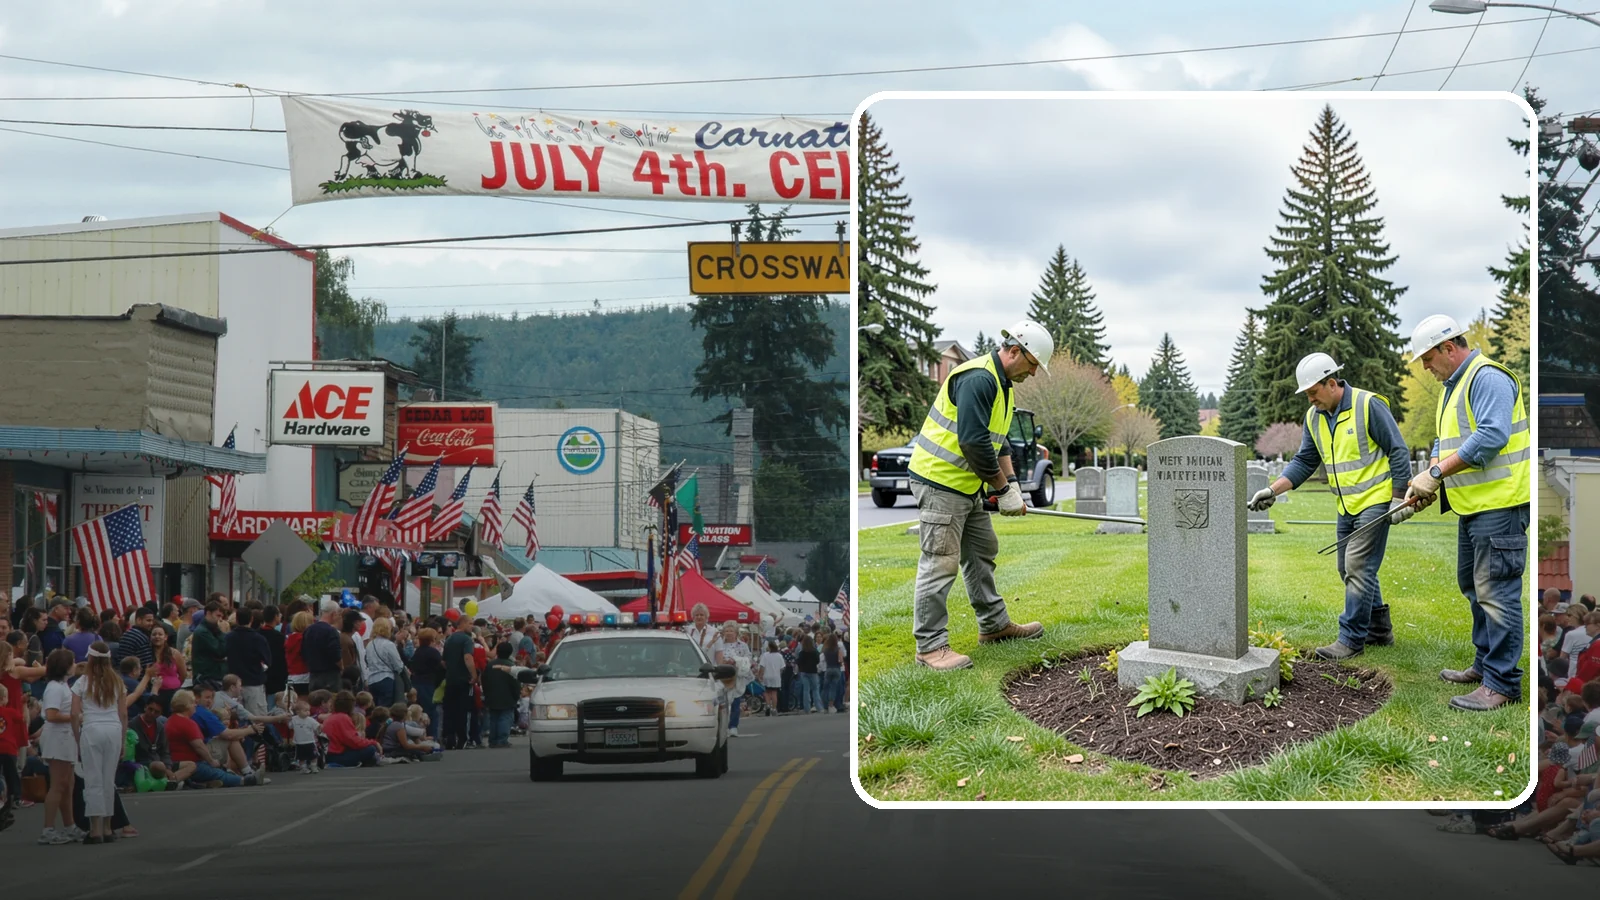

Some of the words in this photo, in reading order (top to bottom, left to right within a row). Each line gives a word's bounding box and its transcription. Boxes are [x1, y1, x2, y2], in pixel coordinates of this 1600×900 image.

[695, 121, 850, 150] Carnat
[481, 141, 605, 192] JULY
[632, 150, 746, 197] 4th.
[697, 254, 850, 280] CROSSWA
[283, 380, 373, 420] ACE
[405, 409, 452, 422] CEDAR
[461, 409, 485, 421] LOG
[283, 421, 371, 437] Hardware
[416, 428, 477, 447] Coca-Cola
[83, 486, 94, 494] St.
[95, 485, 123, 494] Vincent
[126, 486, 136, 494] de
[138, 486, 155, 495] Paul
[688, 526, 741, 535] CRNATION
[699, 535, 730, 543] GLASS
